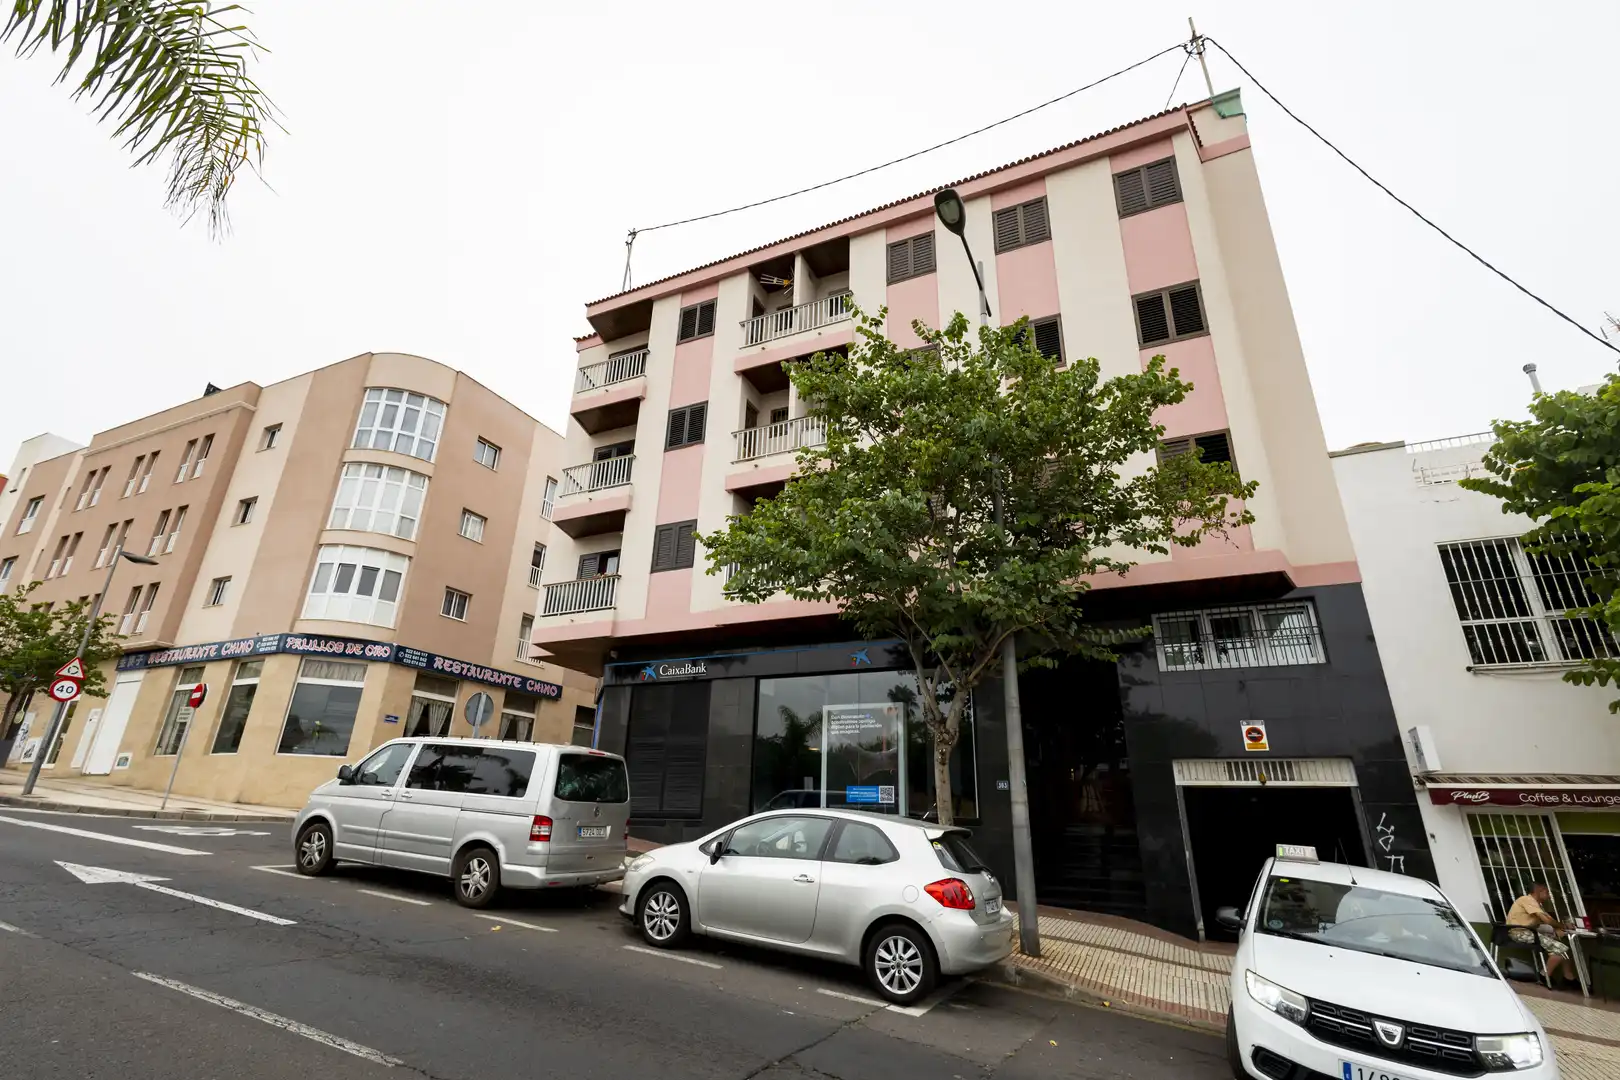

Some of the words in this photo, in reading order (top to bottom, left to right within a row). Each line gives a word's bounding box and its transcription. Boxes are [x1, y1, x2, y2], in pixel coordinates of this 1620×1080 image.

[148, 644, 218, 664] RESTAURANTE
[221, 639, 254, 656] CHINO
[286, 636, 344, 653] PALILLOS
[345, 643, 364, 655] DE
[365, 645, 391, 657] ORO
[660, 662, 706, 676] CaixaBank
[433, 656, 522, 688] RESTAURANTE
[526, 679, 558, 697] CHINO
[56, 685, 74, 694] 40
[1519, 793, 1559, 803] Coffee
[1562, 793, 1571, 803] &
[1573, 794, 1620, 805] Lounge
[1285, 847, 1305, 857] TAXI
